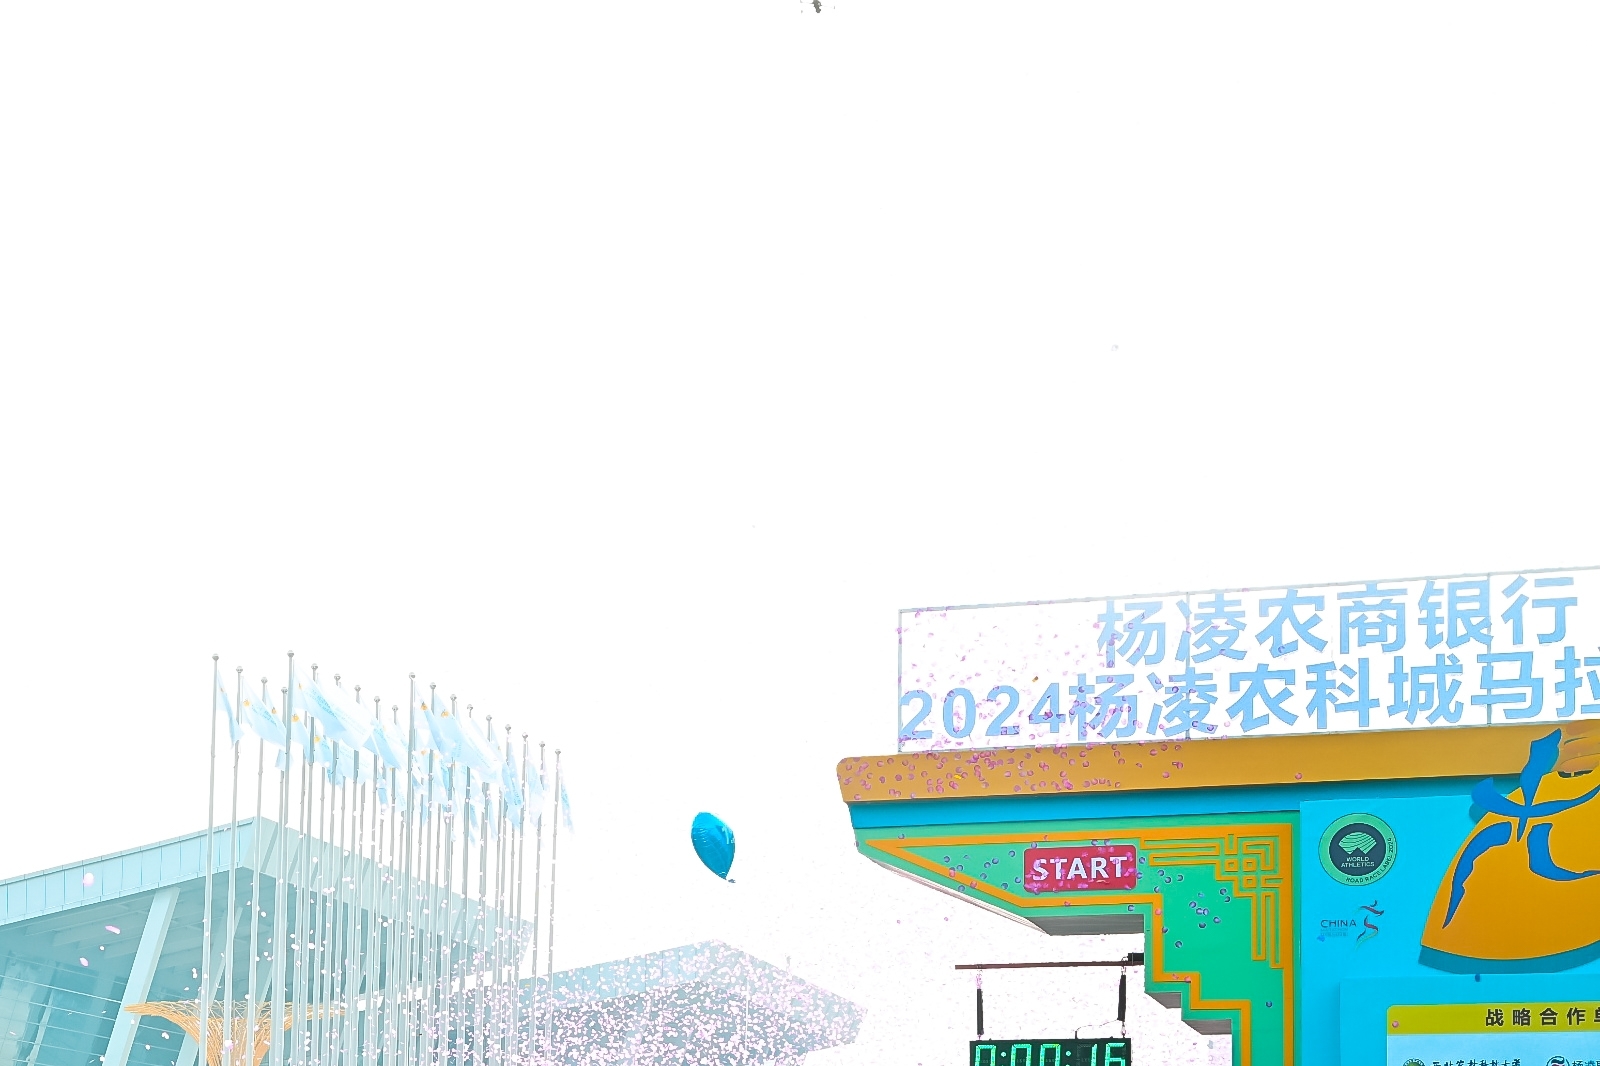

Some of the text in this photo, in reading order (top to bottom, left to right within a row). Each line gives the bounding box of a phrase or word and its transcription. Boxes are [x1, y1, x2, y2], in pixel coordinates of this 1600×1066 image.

[1097, 575, 1578, 669] 杨凌农商银行
[1032, 854, 1128, 883] START
[1320, 919, 1357, 928] CHINA
